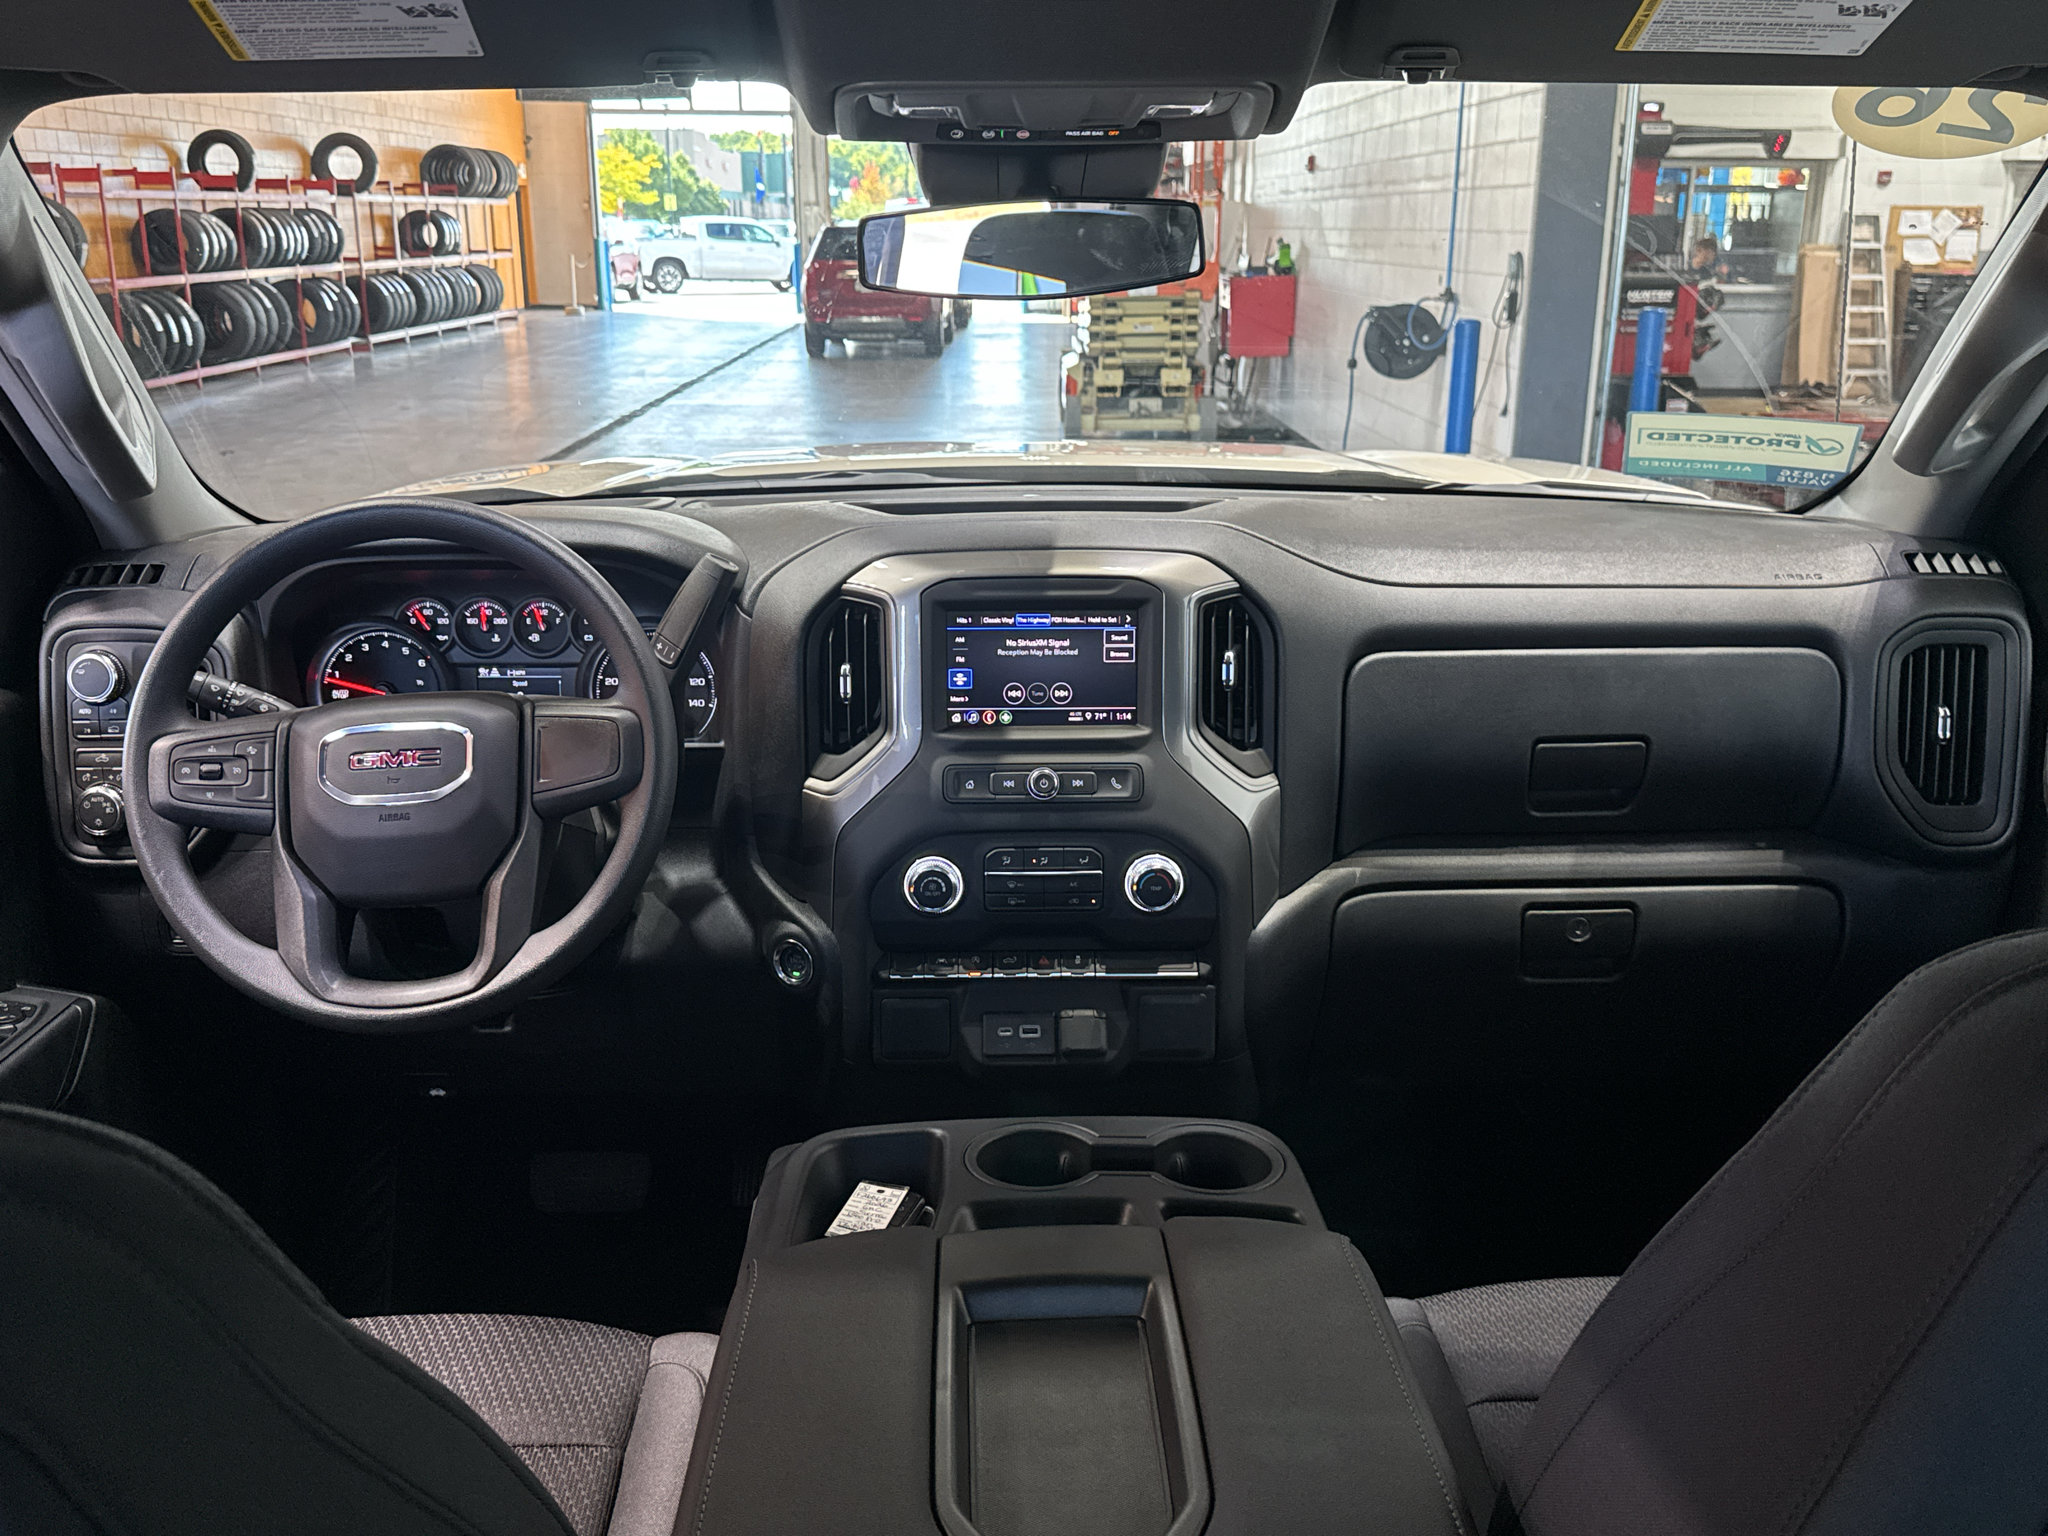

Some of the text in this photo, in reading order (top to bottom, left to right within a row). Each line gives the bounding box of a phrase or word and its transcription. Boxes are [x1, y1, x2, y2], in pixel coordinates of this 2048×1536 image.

[1773, 573, 1823, 581] AIRBAG
[1028, 617, 1050, 626] Highway
[1049, 639, 1070, 648] Signal
[402, 647, 410, 655] 5
[998, 649, 1029, 657] Reception
[1030, 649, 1041, 657] May
[345, 654, 353, 662] 2
[418, 659, 426, 667] 6
[604, 678, 706, 686] 20 120
[688, 699, 706, 707] 140
[1094, 712, 1107, 720] 71°
[1116, 712, 1132, 720] 1:14
[349, 749, 441, 770] GMC
[378, 812, 411, 823] AIRBAG
